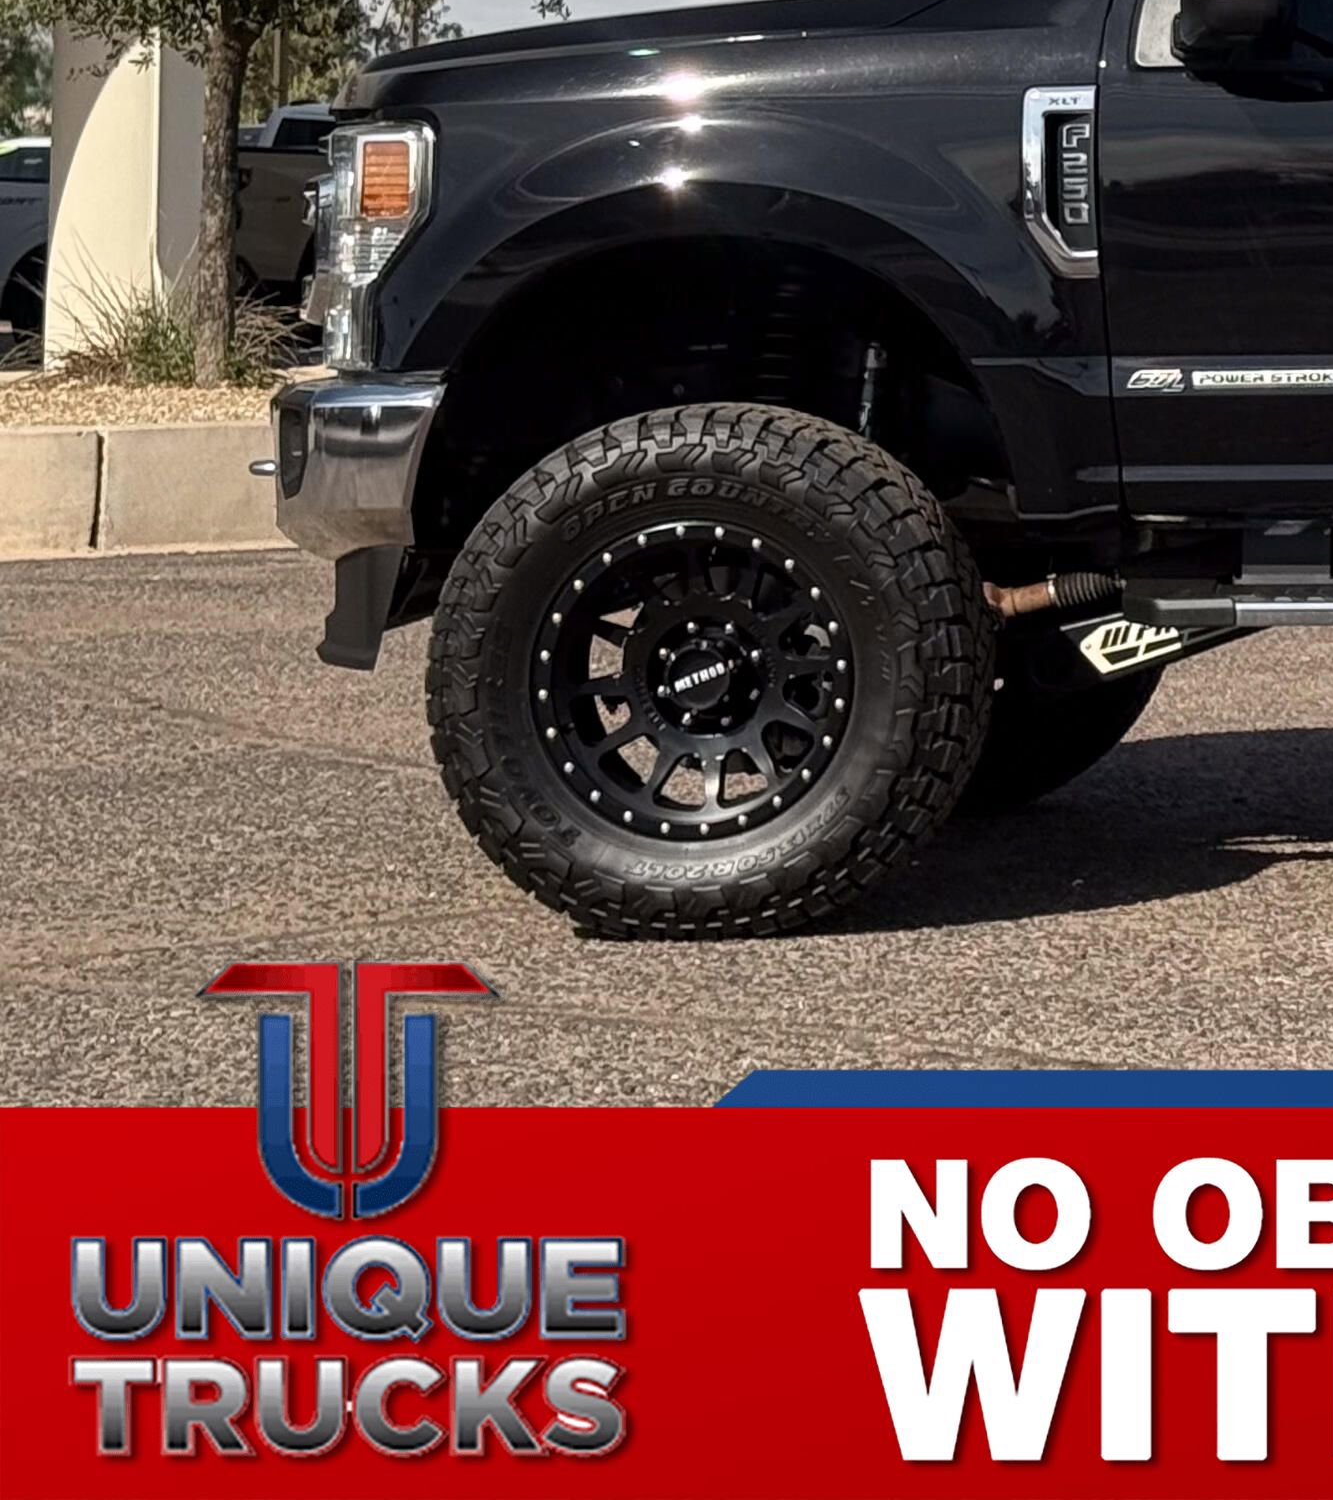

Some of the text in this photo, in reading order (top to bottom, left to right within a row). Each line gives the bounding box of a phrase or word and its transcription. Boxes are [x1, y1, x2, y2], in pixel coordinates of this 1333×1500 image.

[1048, 97, 1080, 105] XLT
[1199, 372, 1264, 384] POWER
[674, 662, 725, 693] METHOD
